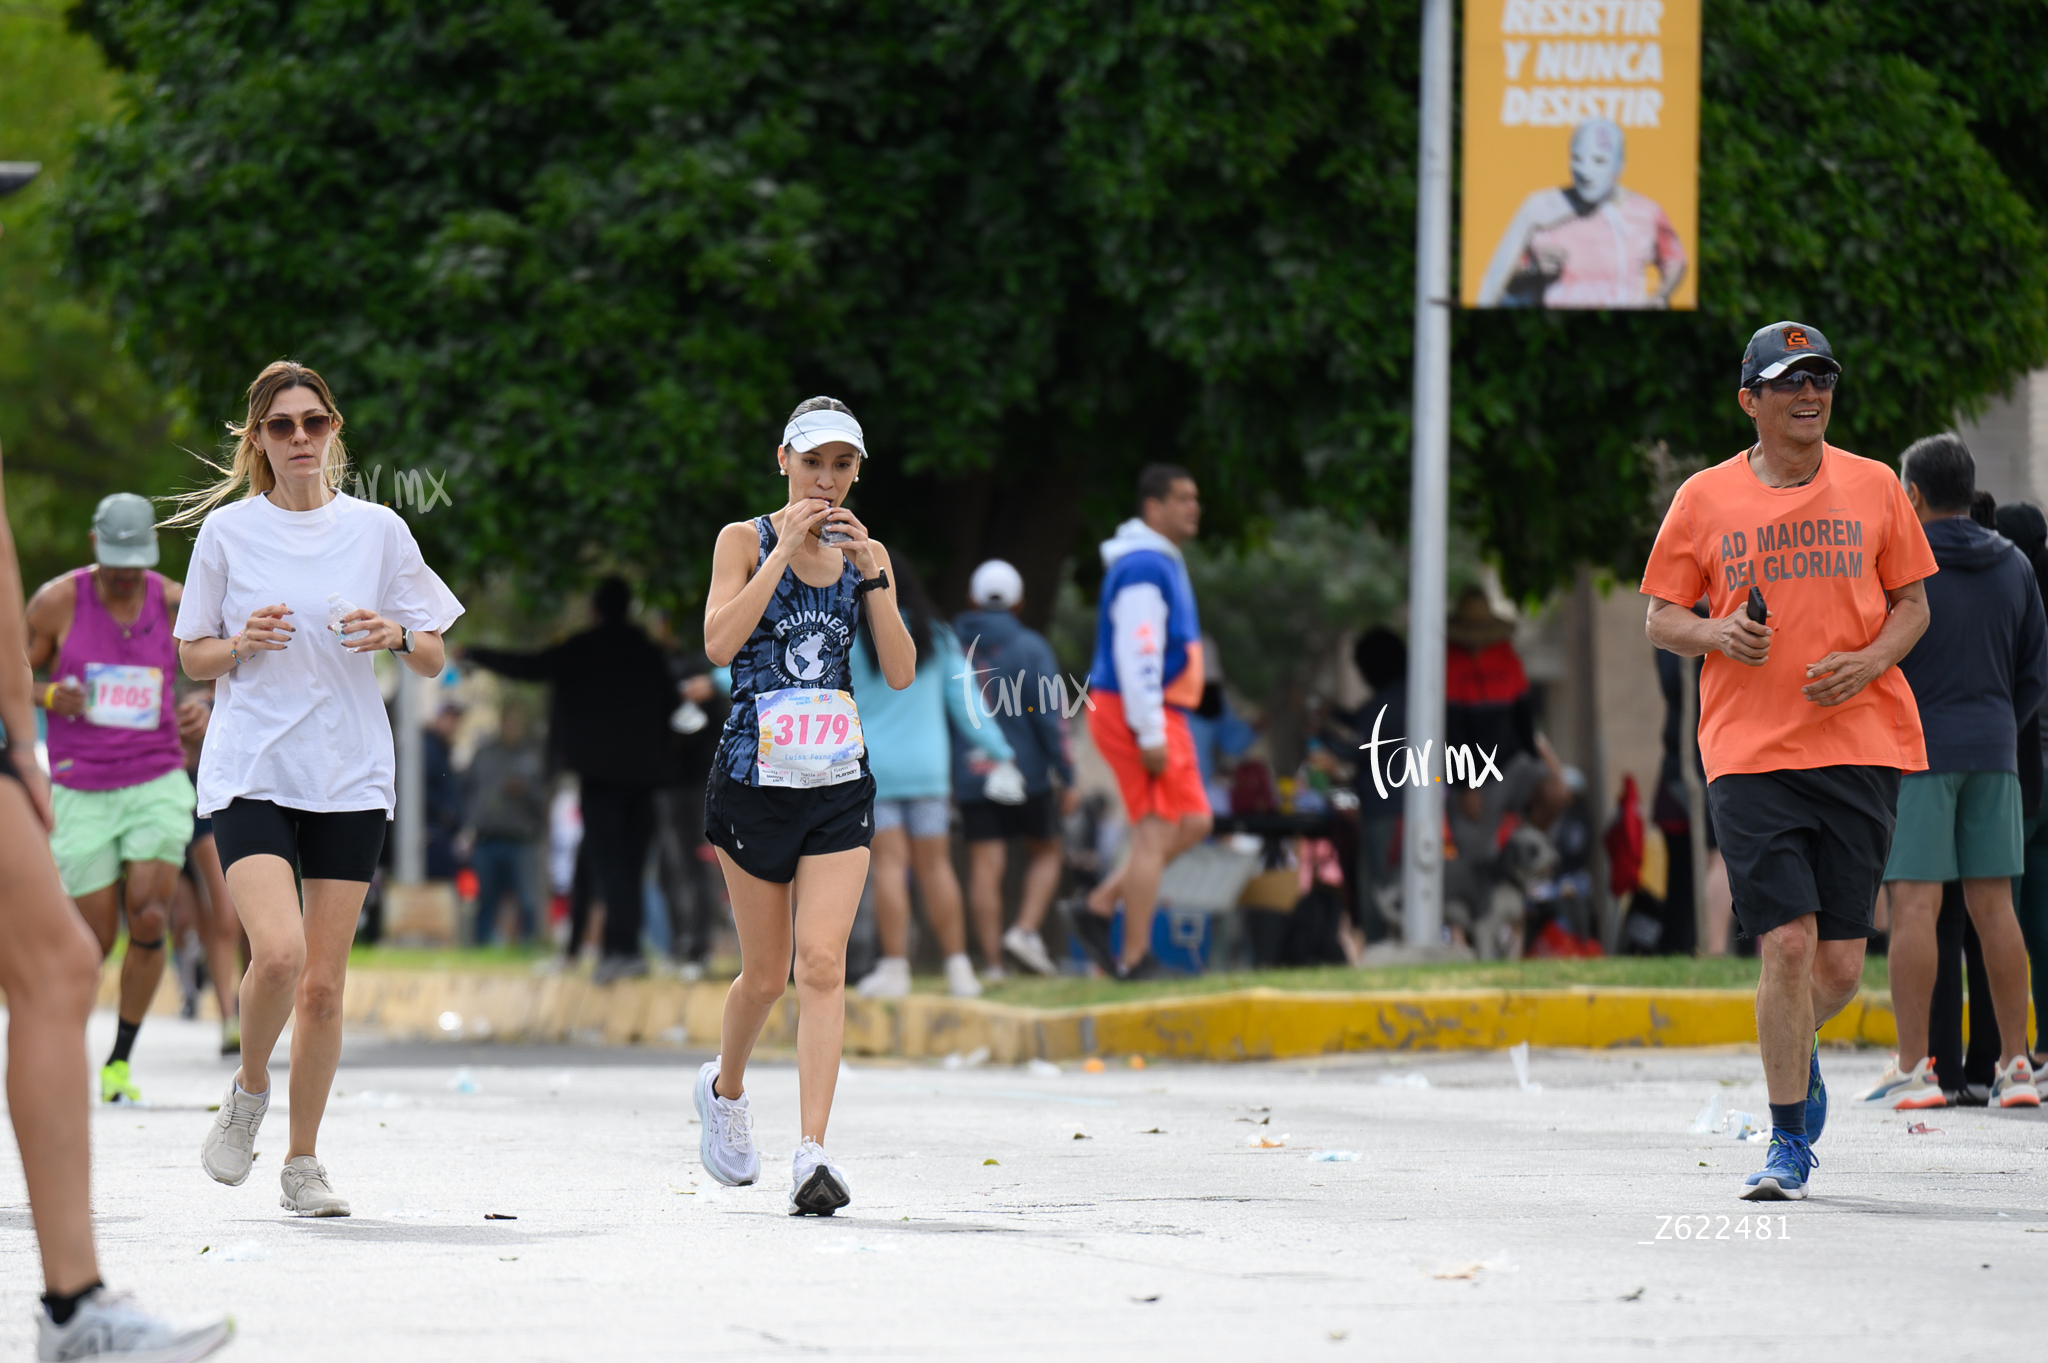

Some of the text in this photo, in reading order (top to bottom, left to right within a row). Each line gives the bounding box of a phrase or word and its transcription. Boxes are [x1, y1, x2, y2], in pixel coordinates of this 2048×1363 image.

[1501, 0, 1665, 35] RESISTIR
[1502, 41, 1664, 82] Y NUNCA
[1501, 86, 1664, 128] DESISTIR
[1721, 519, 1862, 562] AD MAIOREM
[1724, 550, 1862, 592] DEI GLORIAM
[773, 610, 850, 646] RUNNERS
[770, 663, 791, 685] AROUND
[98, 683, 153, 710] 1805
[774, 714, 849, 746] 3179
